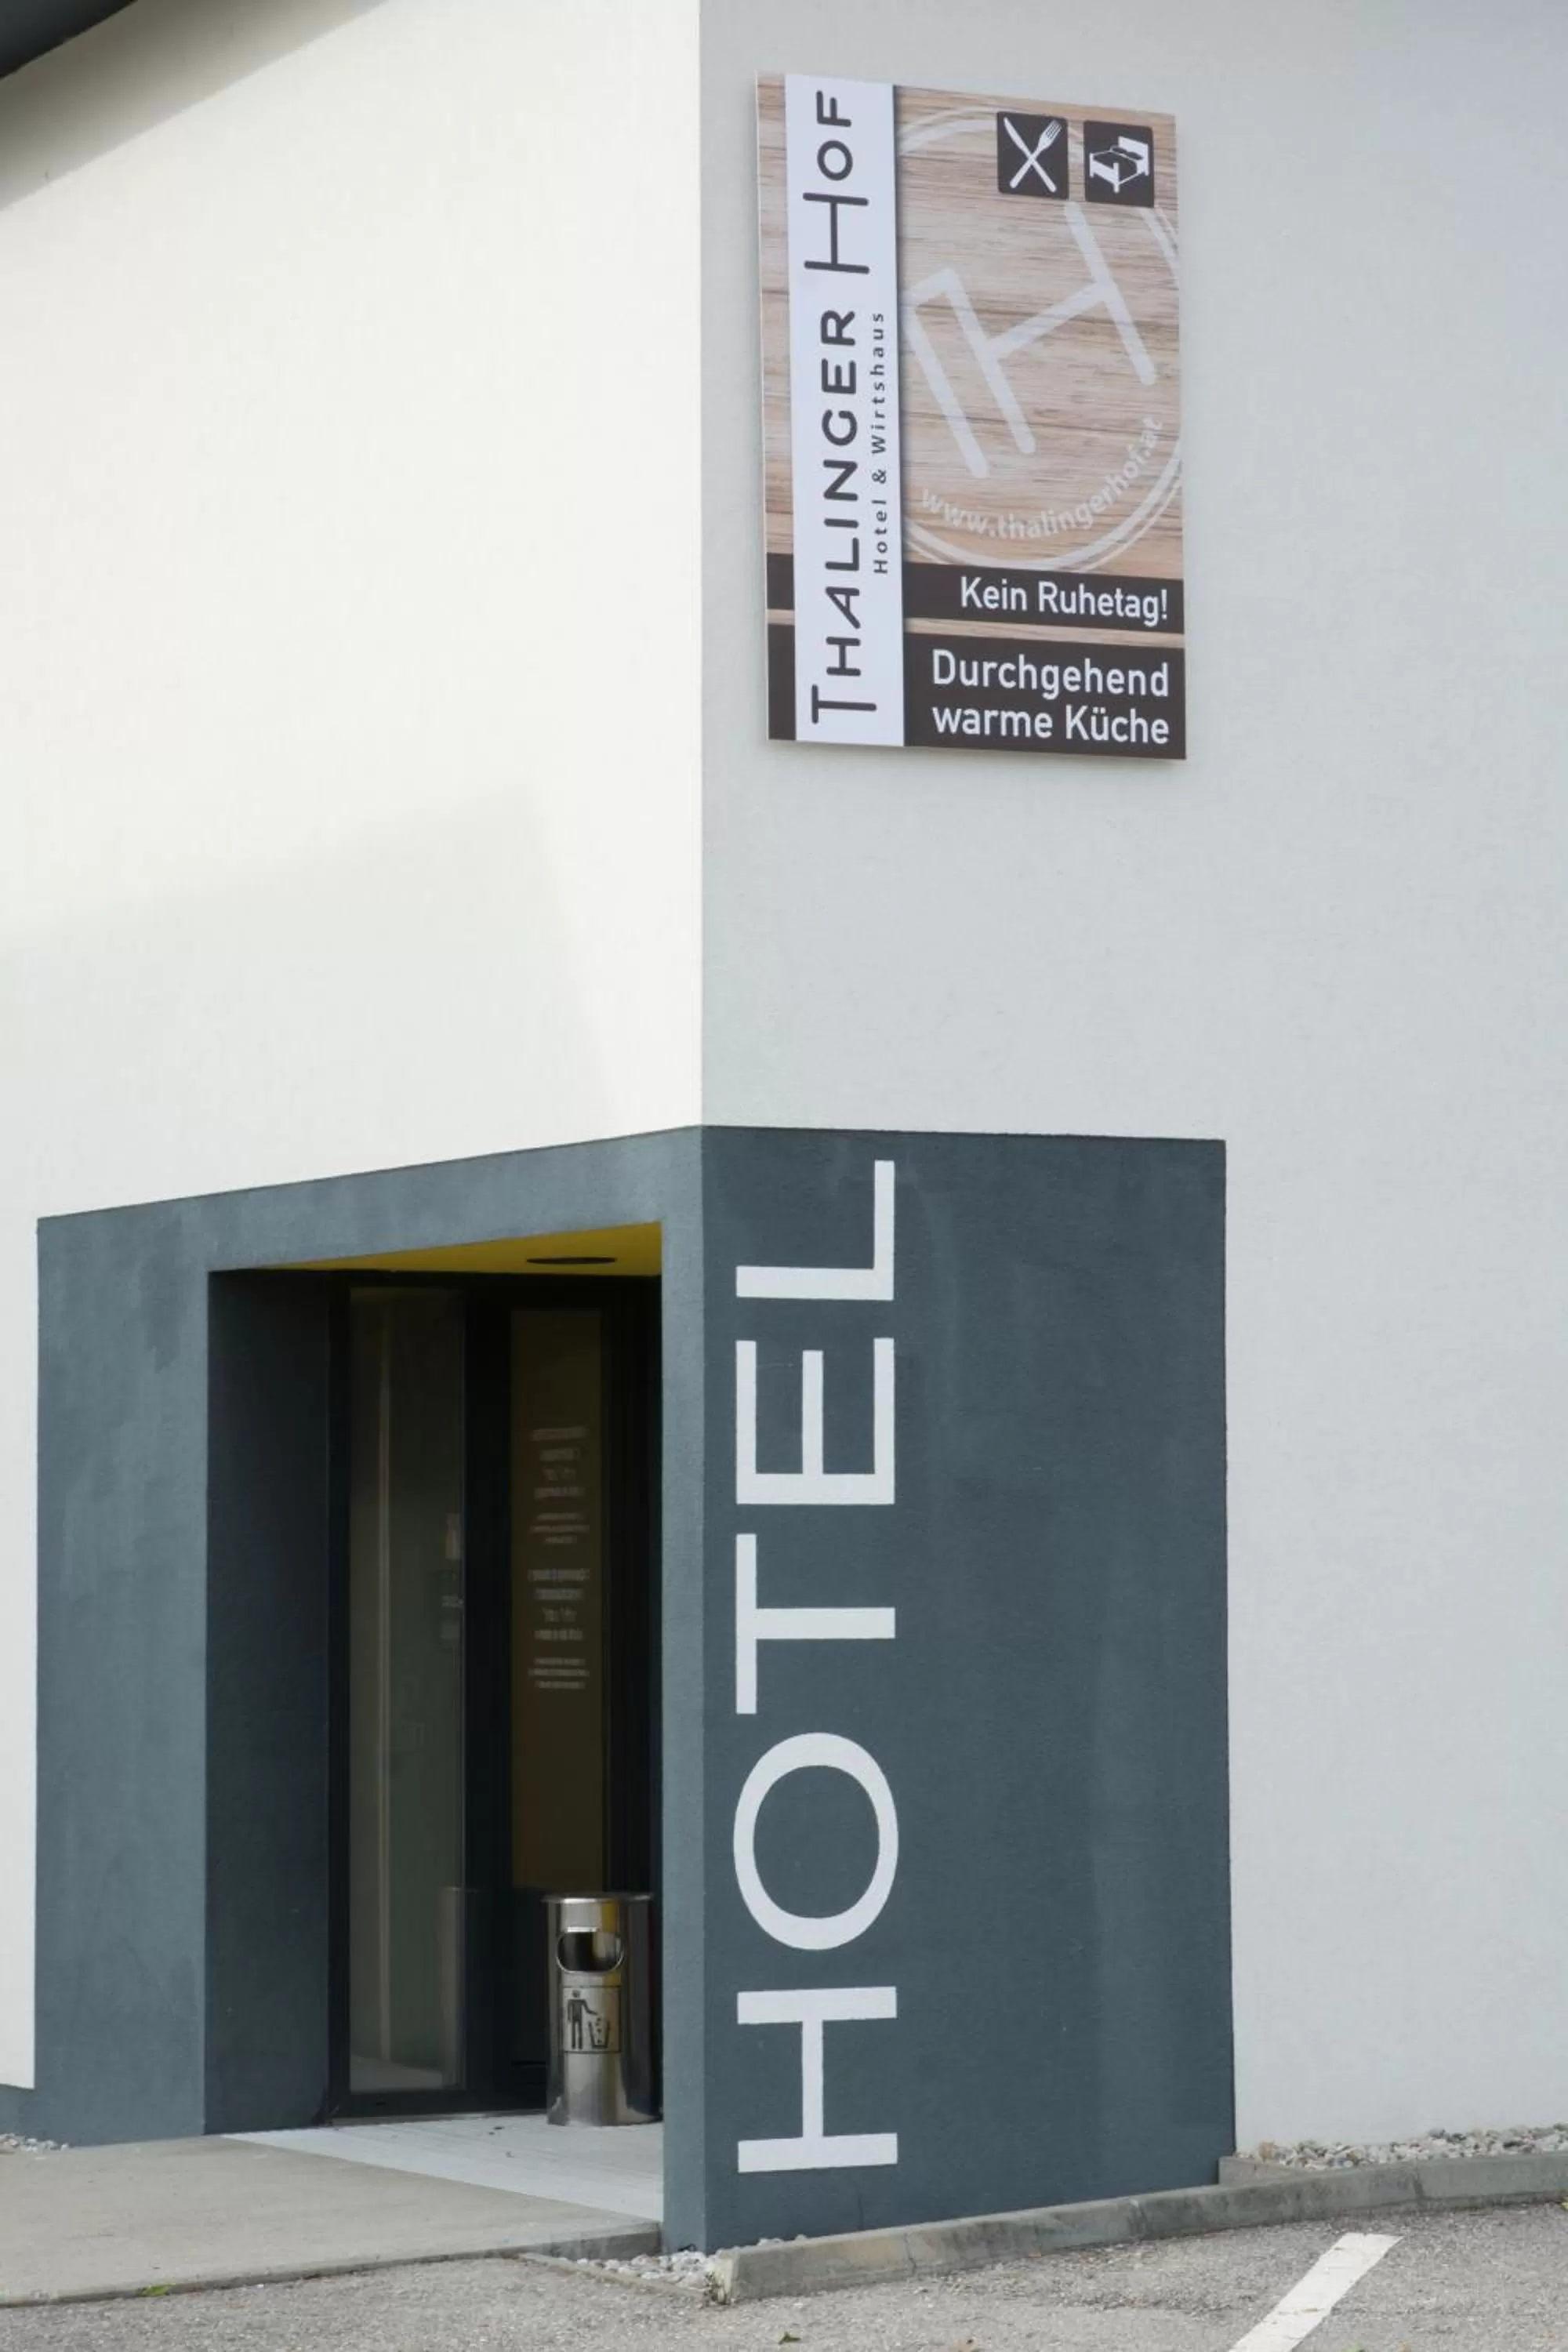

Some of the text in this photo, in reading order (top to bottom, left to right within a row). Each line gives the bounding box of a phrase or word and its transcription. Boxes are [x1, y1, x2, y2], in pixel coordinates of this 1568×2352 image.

[802, 89, 877, 724] THALINGER HOF
[869, 313, 888, 575] Hotel & Wirtshaus
[921, 416, 1163, 540] www.thalingerhof.at
[960, 575, 1168, 627] Kein Ruhetag!
[931, 648, 1169, 700] Durchgehend
[931, 703, 1170, 744] warme Küche
[733, 1160, 899, 2173] HOTEL
